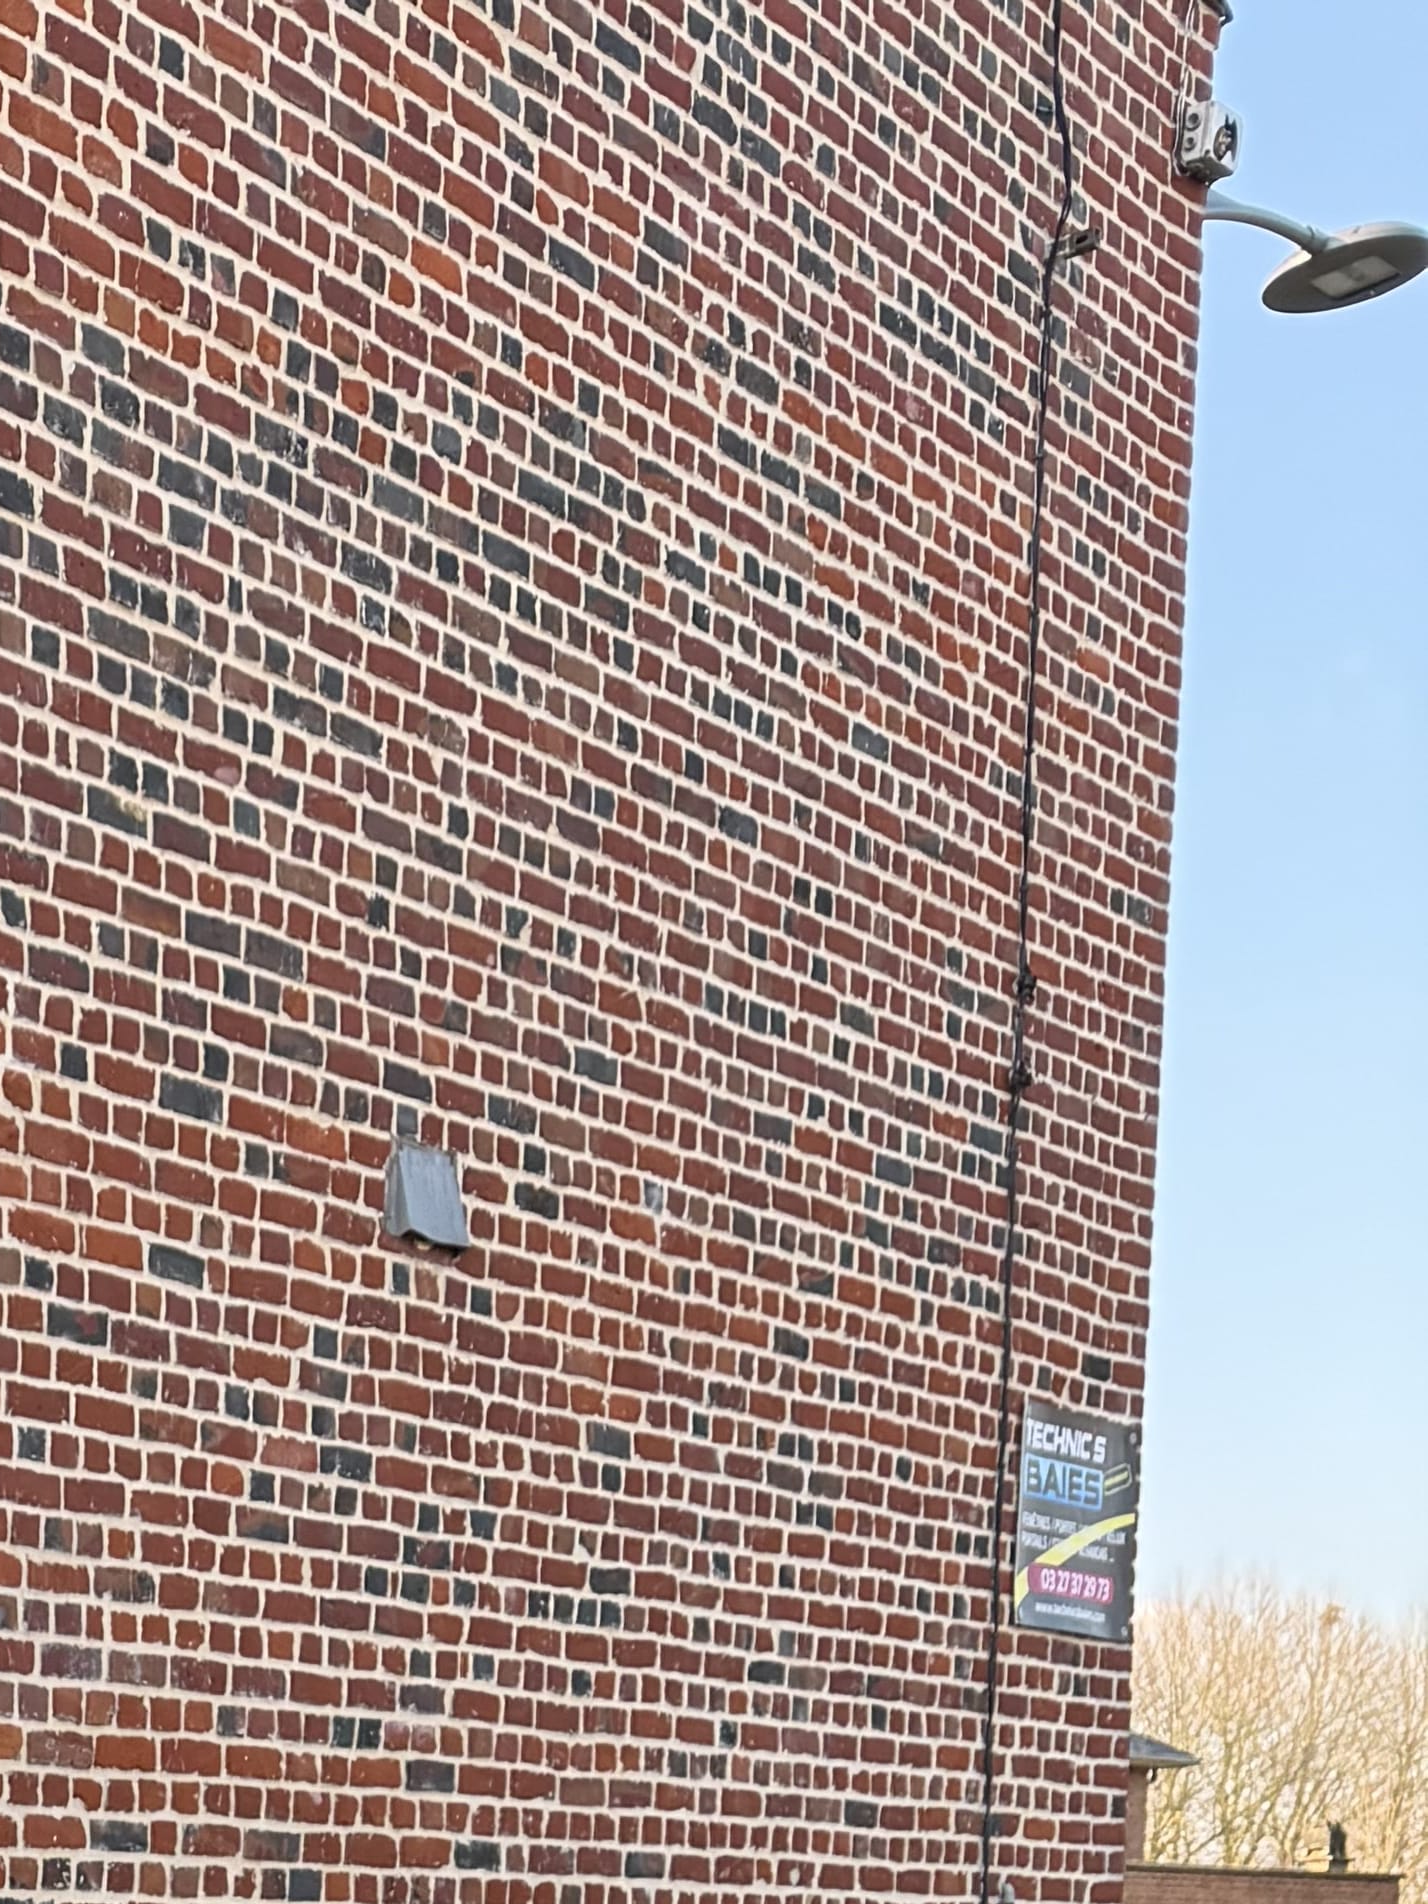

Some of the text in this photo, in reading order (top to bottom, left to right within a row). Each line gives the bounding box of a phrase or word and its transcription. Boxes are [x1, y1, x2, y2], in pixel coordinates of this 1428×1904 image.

[1026, 1459, 1101, 1506] BAIES
[1040, 1568, 1056, 1592] 03
[1096, 1577, 1111, 1601] 73
